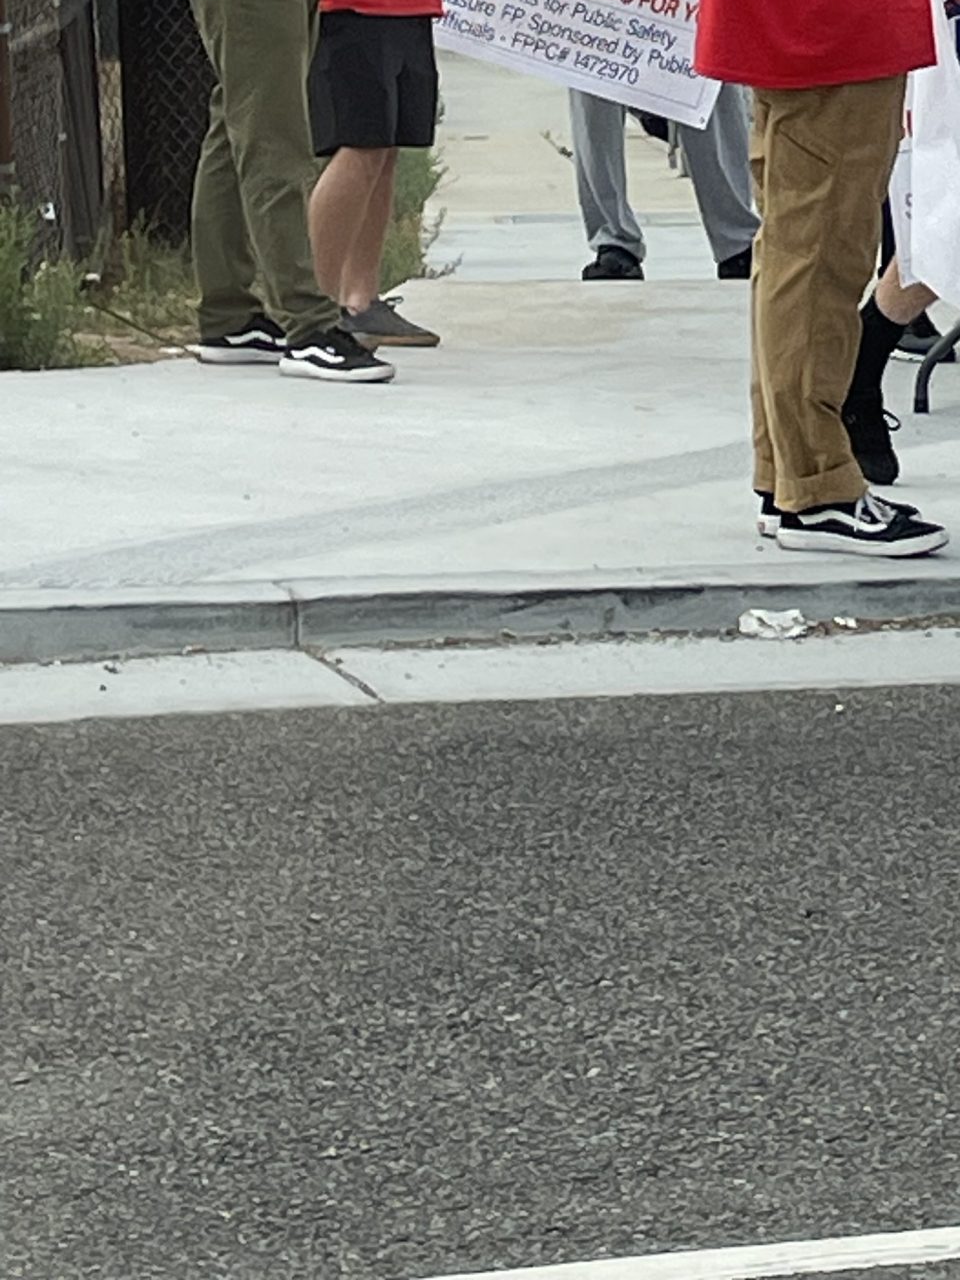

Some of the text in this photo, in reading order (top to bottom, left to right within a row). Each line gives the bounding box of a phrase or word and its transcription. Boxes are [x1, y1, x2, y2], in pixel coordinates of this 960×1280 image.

[432, 9, 640, 86] fficials FPPC# 1472970
[527, 13, 620, 56] Sponsored
[622, 40, 644, 66] by
[647, 48, 698, 80] Public
[570, 1, 623, 32] Public
[625, 18, 678, 52] Safety
